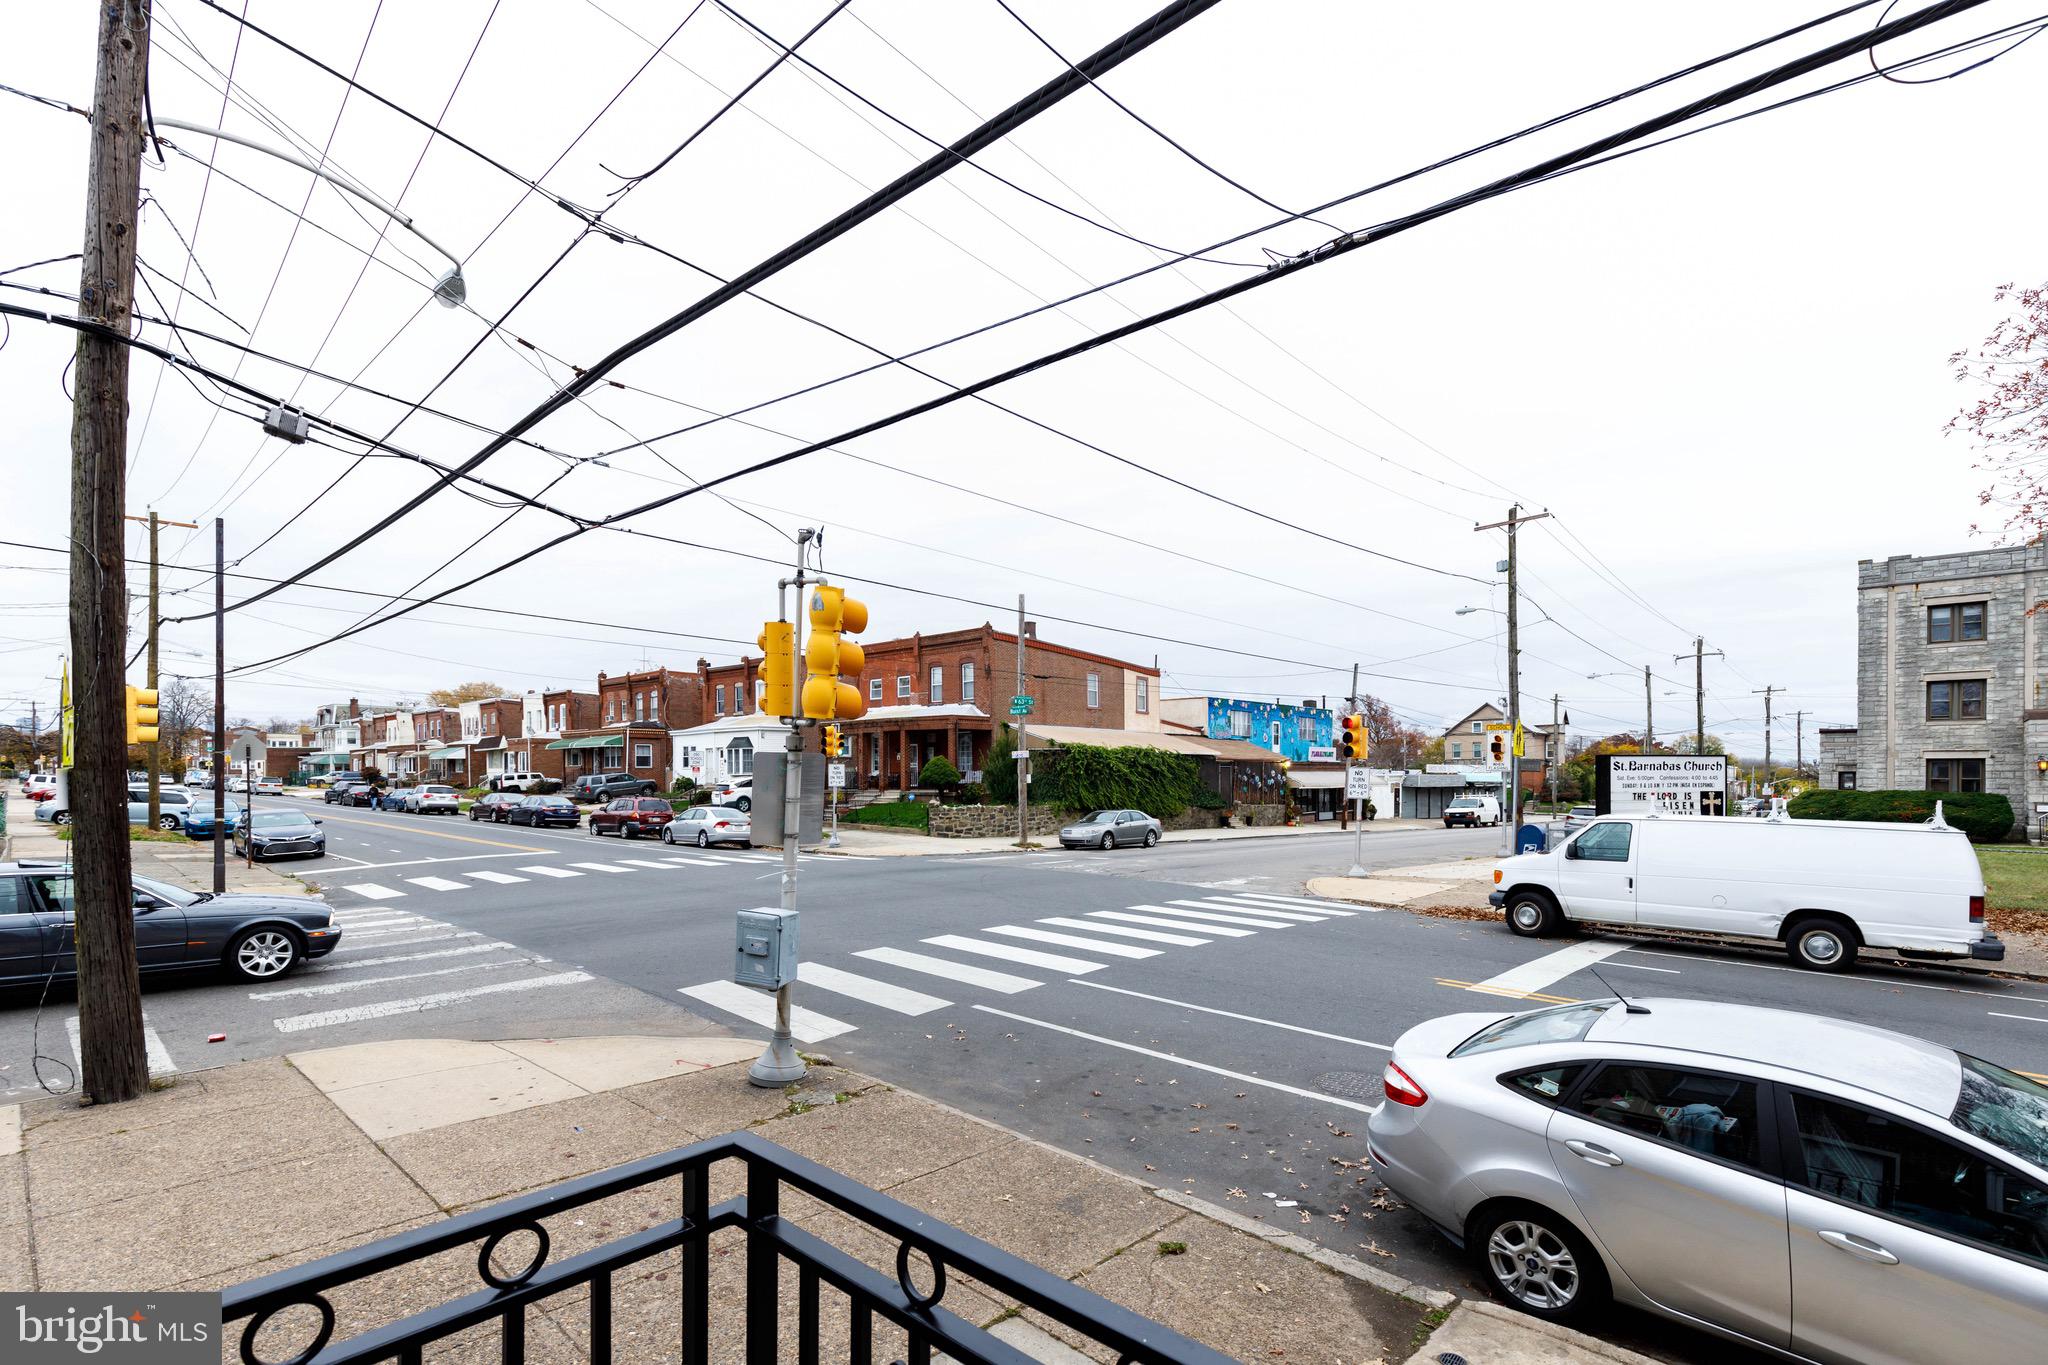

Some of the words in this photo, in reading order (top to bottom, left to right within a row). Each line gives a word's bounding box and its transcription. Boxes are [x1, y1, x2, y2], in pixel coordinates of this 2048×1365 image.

[1613, 761, 1627, 771] St.
[1629, 761, 1681, 771] Barnabas
[1684, 761, 1723, 771] Church
[1632, 792, 1647, 800] THE
[1657, 792, 1677, 800] LORD
[1684, 792, 1692, 800] IS
